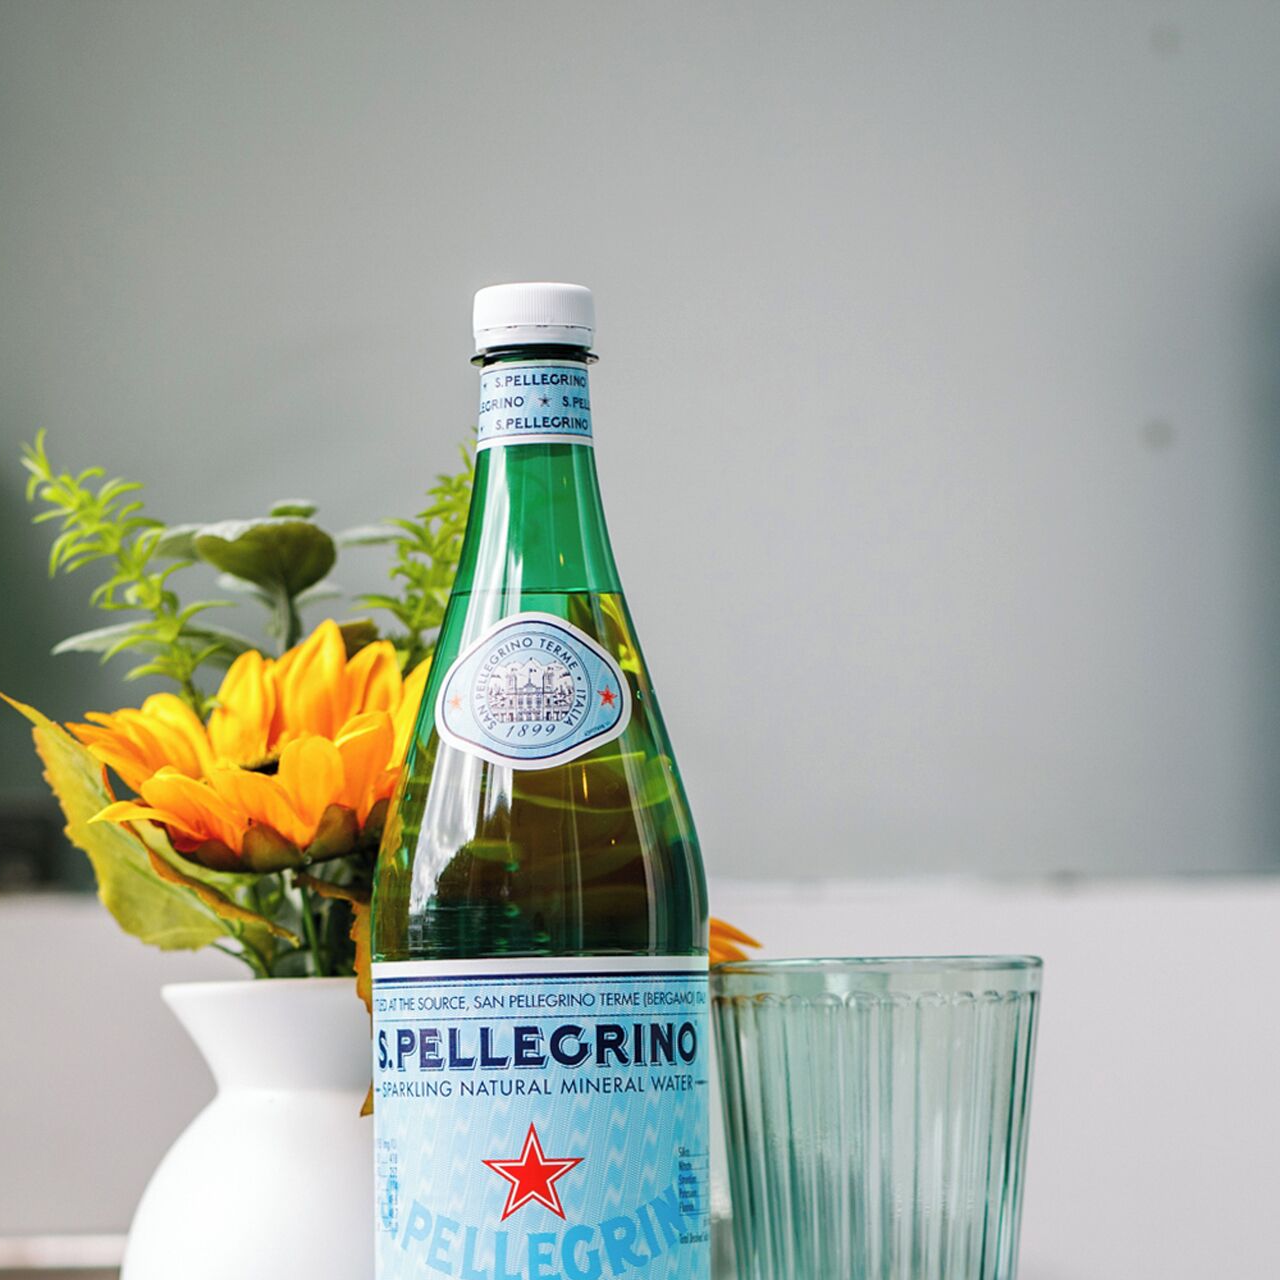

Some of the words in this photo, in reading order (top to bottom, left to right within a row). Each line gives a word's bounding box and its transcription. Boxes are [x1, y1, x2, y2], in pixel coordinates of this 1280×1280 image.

[495, 374, 586, 388] S.PELLEGRINO
[495, 416, 589, 430] S.PELLEGRINO
[540, 638, 578, 670] TERME
[475, 637, 533, 700] PELLEGRINO
[477, 704, 497, 730] SAN
[563, 689, 586, 726] ITALIA
[506, 723, 556, 738] 1899
[399, 998, 415, 1011] THE
[418, 996, 469, 1011] SOURCE,
[474, 995, 504, 1009] SAN
[509, 993, 596, 1008] PELLEGRINO
[600, 992, 640, 1006] TERME
[378, 1021, 698, 1072] S.PELLEGRINO
[382, 1080, 453, 1098] SPARKLING
[460, 1079, 552, 1097] NATURAL
[561, 1076, 644, 1095] MINERAL
[651, 1075, 693, 1092] WATER
